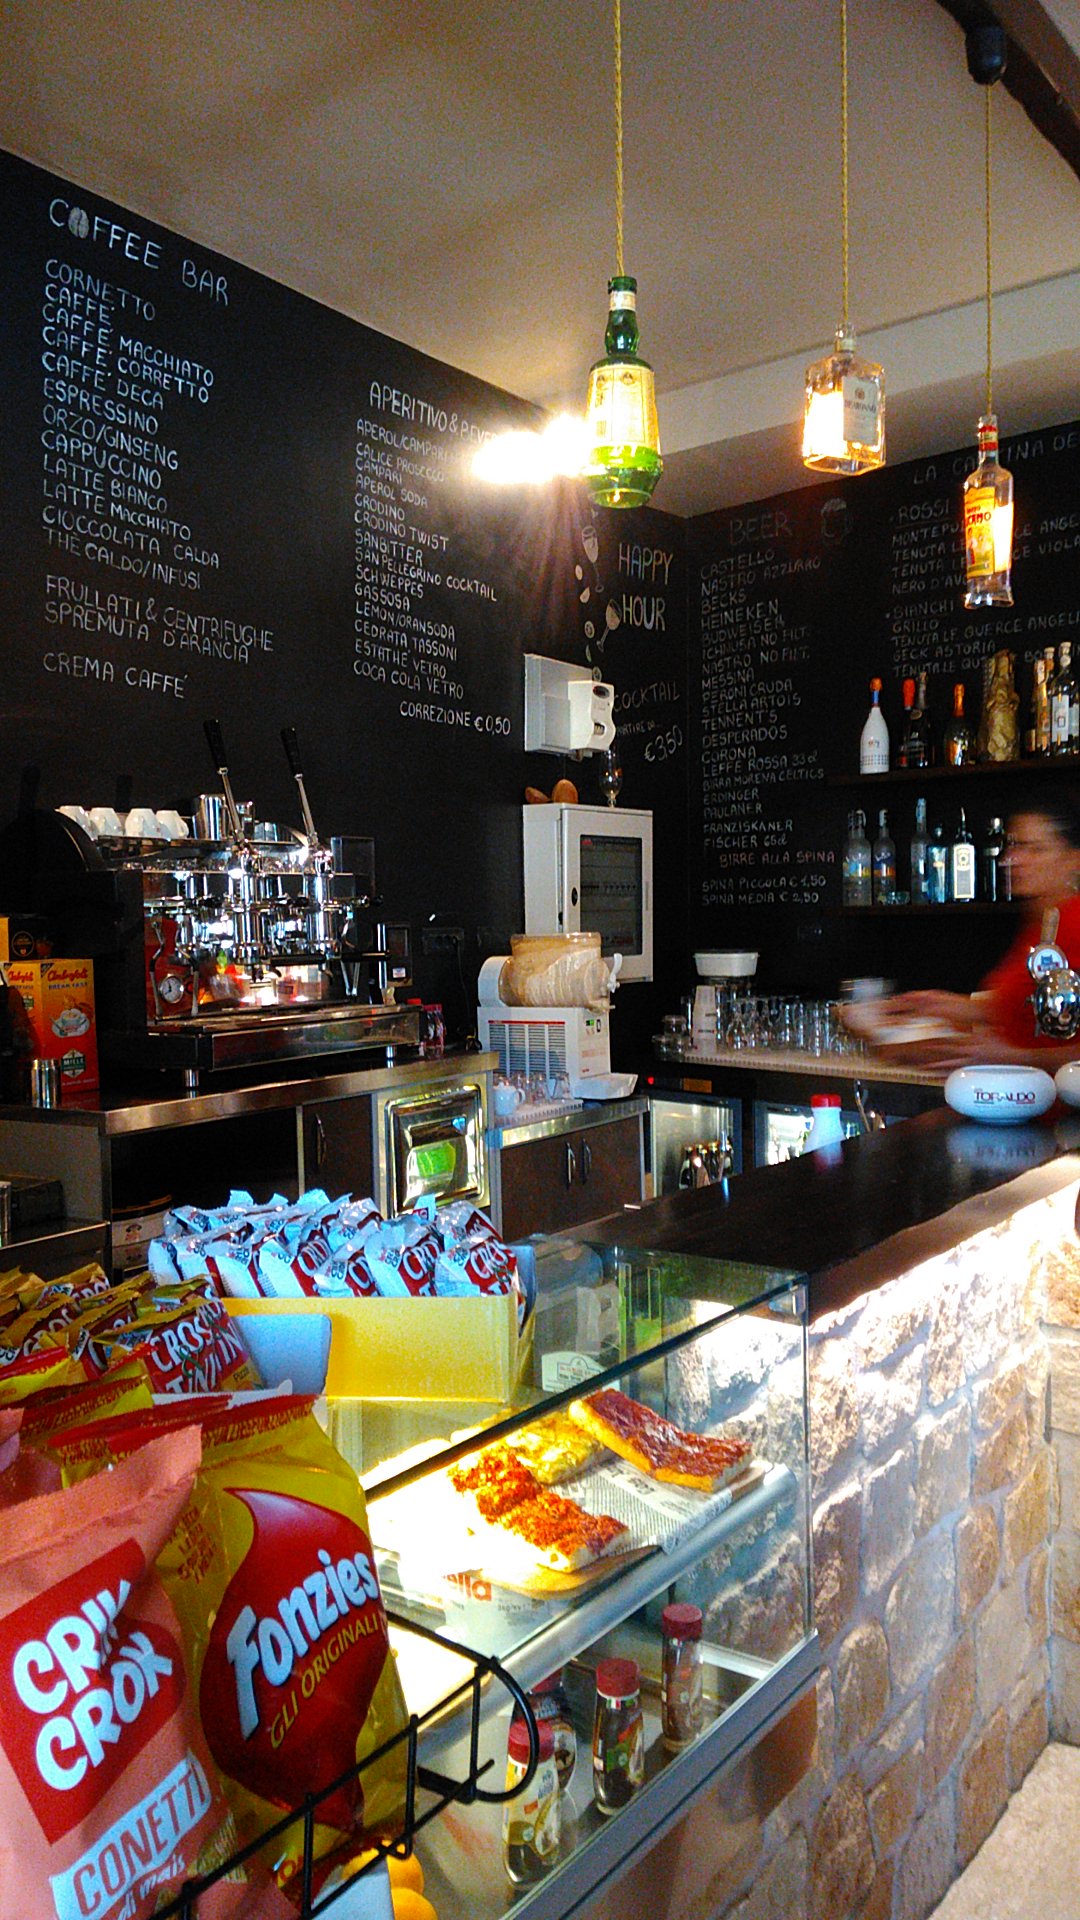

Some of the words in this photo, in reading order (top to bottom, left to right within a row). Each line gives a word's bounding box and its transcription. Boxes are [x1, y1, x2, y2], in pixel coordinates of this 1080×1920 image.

[45, 258, 157, 322] CORNETTO
[182, 258, 229, 307] BAR
[119, 335, 215, 387] MACCHIATO
[116, 378, 164, 410] DECA
[117, 356, 209, 404] CORRETTO
[43, 377, 159, 436] ESPRESSINO
[369, 381, 448, 432] APERITIVO
[448, 412, 458, 433] &
[42, 403, 180, 470] ORZO/GINSENG
[356, 418, 447, 462] APEROL/CAMPARI
[41, 429, 162, 490] CAPPUCCINO
[355, 457, 403, 486] CAMPARI
[356, 442, 393, 468] CALICE
[396, 456, 445, 482] PROSECCO
[913, 465, 937, 485] LA
[43, 453, 106, 492] LATTE
[110, 478, 168, 513] BIANCO
[355, 473, 397, 501] APEROL
[400, 488, 429, 509] SODA
[43, 478, 106, 516] LATTE
[110, 501, 191, 541] MACCHIATO
[897, 499, 950, 522] ROSSI
[42, 504, 161, 556] CIOCCOLATA
[173, 544, 220, 569] CALDA
[354, 509, 406, 539] CRODINO
[409, 525, 450, 552] TWIST
[728, 510, 794, 546] BEER
[355, 527, 424, 567] SANBITTER
[618, 542, 674, 585] HAPPY
[892, 542, 946, 563] TENUTA
[84, 542, 201, 590] CALDO/INFUSI
[700, 548, 776, 581] CASTELLO
[891, 558, 944, 578] TENUTA
[355, 583, 411, 612] GASSOSA
[446, 575, 497, 602] COCKTAIL
[701, 571, 757, 598] NASTRO
[891, 579, 926, 595] NERO
[46, 574, 141, 621] FRULLATI
[145, 597, 158, 624] &
[162, 606, 275, 652] CENTRIFUGHE
[622, 593, 667, 632] HOUR
[701, 588, 748, 616] BECKS
[701, 598, 780, 631] HEINEKEN
[44, 601, 150, 642] SPREMUTA
[162, 629, 249, 664] D'ARANCIA
[356, 600, 456, 642] LEMON/ORANSODA
[701, 614, 785, 648] BUDWEISER
[355, 619, 408, 648] CEDRATA
[412, 636, 458, 661] TASSONI
[760, 633, 778, 647] NO
[43, 652, 115, 683] CREMA
[353, 659, 386, 683] COCA
[391, 670, 421, 691] COLA
[426, 677, 464, 700] VETRO
[413, 658, 447, 680] VETRO
[702, 654, 752, 676] NASTRO
[760, 650, 779, 665] NO
[702, 667, 755, 691] MESSINA
[702, 685, 748, 703] PERONI
[749, 678, 793, 697] CRUDA
[702, 699, 748, 718] STELLA
[750, 692, 802, 711] ARTOIS
[400, 700, 471, 727] CORREZIONE
[702, 724, 788, 749] DESPERADOS
[701, 745, 757, 765] CORONA
[702, 760, 742, 779] LEFFE
[747, 754, 788, 772] ROSSA
[703, 786, 760, 806] ERDINGER
[703, 802, 763, 820] PAULANER
[703, 818, 794, 835] FRANZISKANER
[703, 834, 759, 849] FISCHER
[720, 852, 757, 869] BIRRE
[761, 850, 790, 865] ALLA
[796, 850, 836, 865] SPINA
[701, 877, 735, 893] SPINA
[739, 876, 787, 891] PICCOLA
[701, 893, 735, 907] SPINA
[738, 892, 775, 905] MEDIA
[976, 1091, 1036, 1102] TORALDO
[12, 1578, 132, 1715] CRIK
[225, 1548, 379, 1742] Fonzies
[269, 1705, 301, 1750] GLI
[300, 1613, 380, 1698] ORIGINALI
[35, 1630, 174, 1791] CROK
[72, 1759, 209, 1918] CONETTI
[139, 1852, 187, 1900] mais
